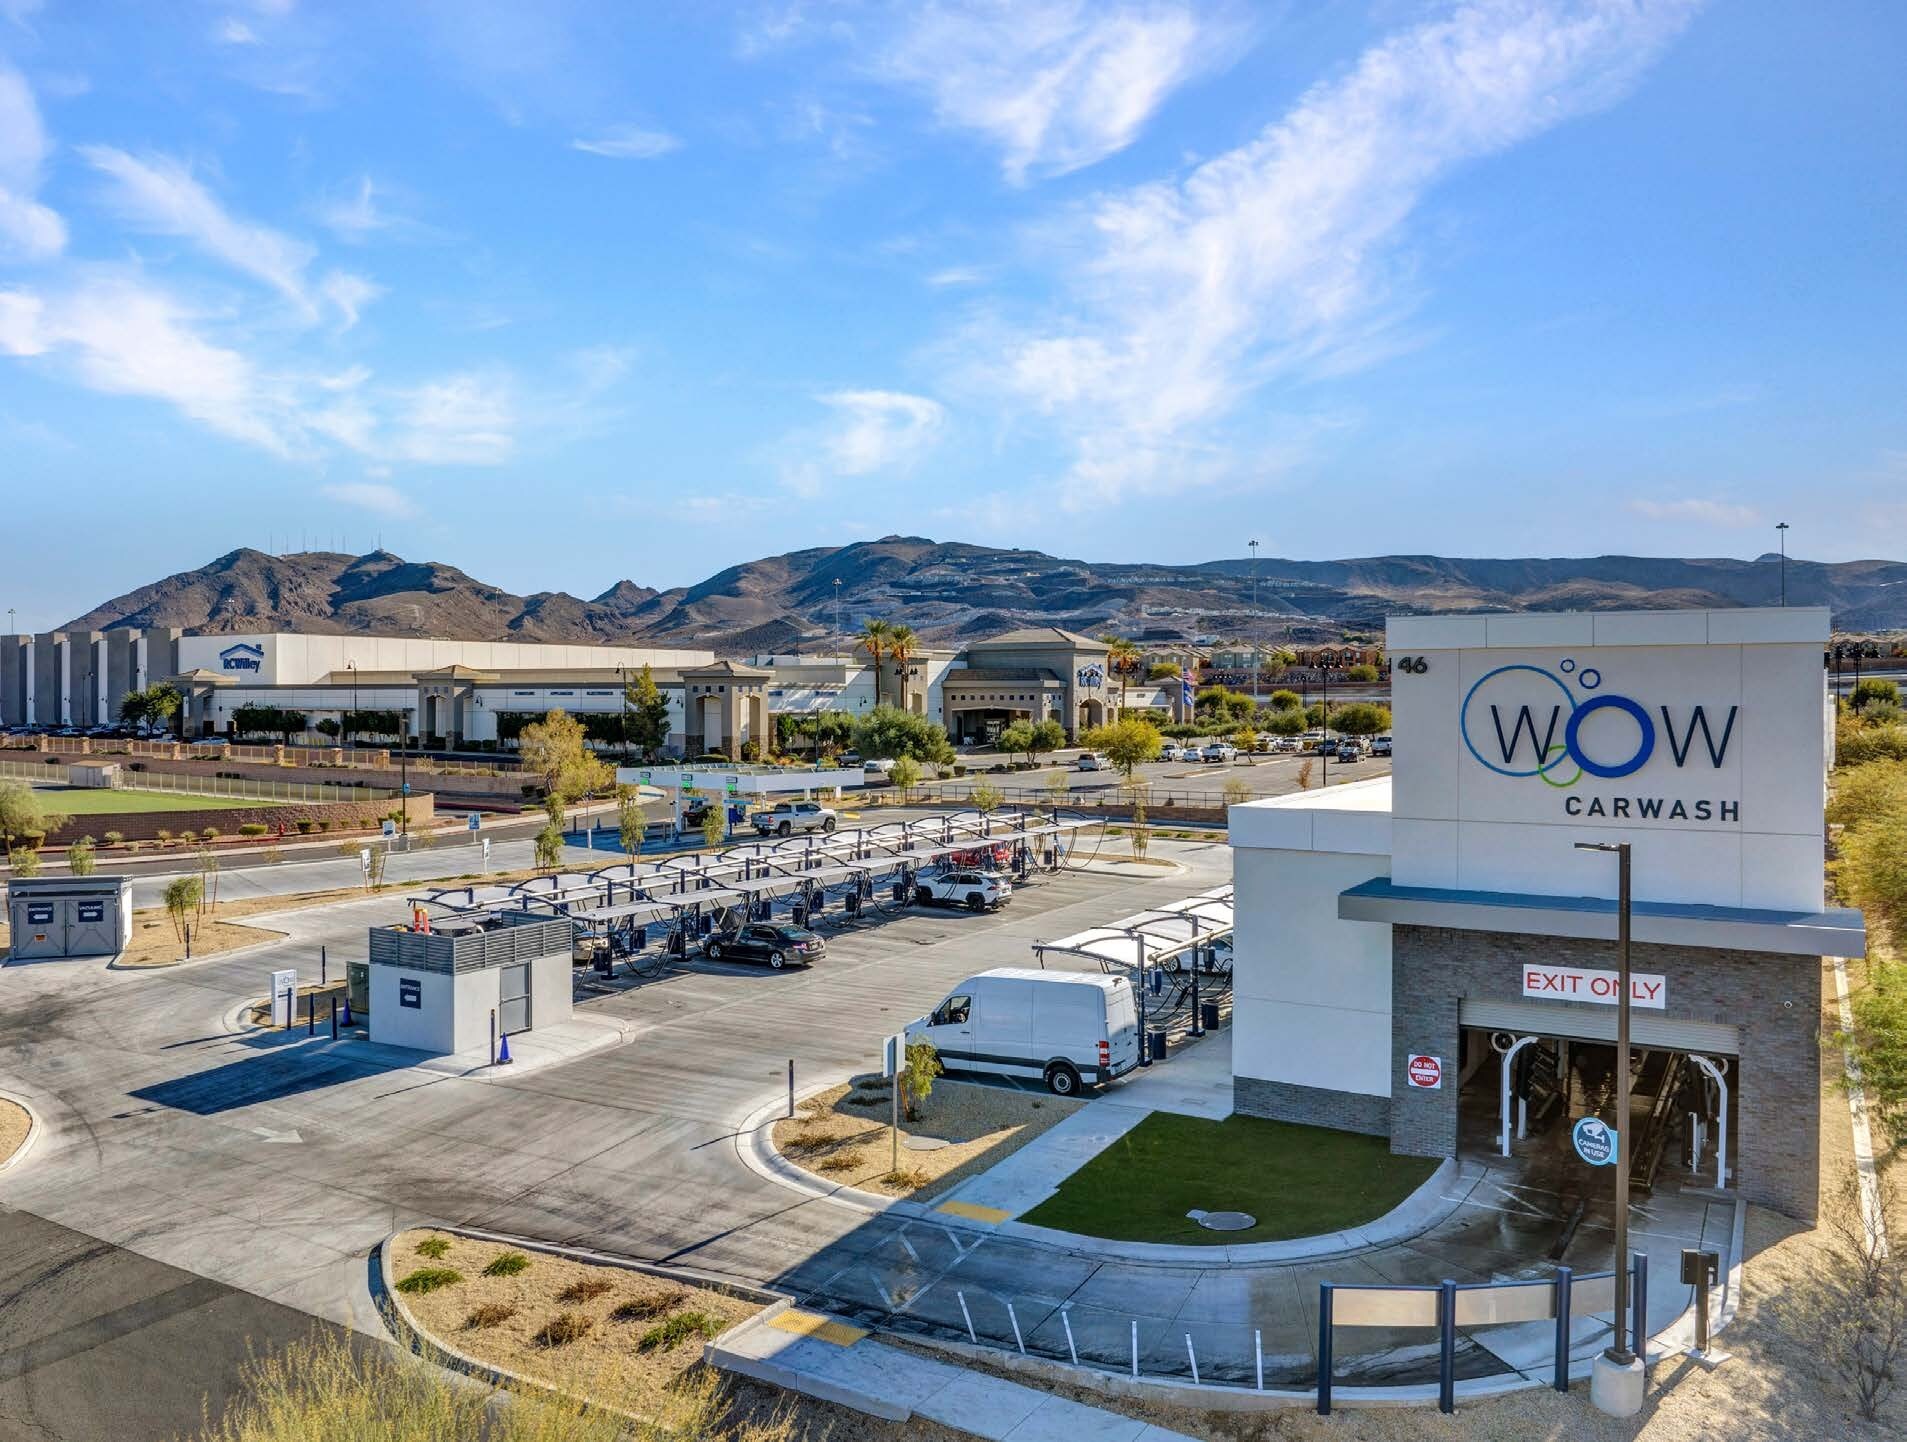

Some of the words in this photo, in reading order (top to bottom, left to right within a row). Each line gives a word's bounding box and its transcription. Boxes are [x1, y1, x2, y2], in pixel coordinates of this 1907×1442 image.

[1397, 656, 1427, 674] 46
[1491, 694, 1739, 779] WOW
[1565, 796, 1740, 822] CARWASH
[1526, 972, 1583, 993] EXIT
[1423, 1062, 1436, 1070] NOT
[1415, 1074, 1434, 1082] ENTER
[1578, 1138, 1610, 1153] CAMERAS
